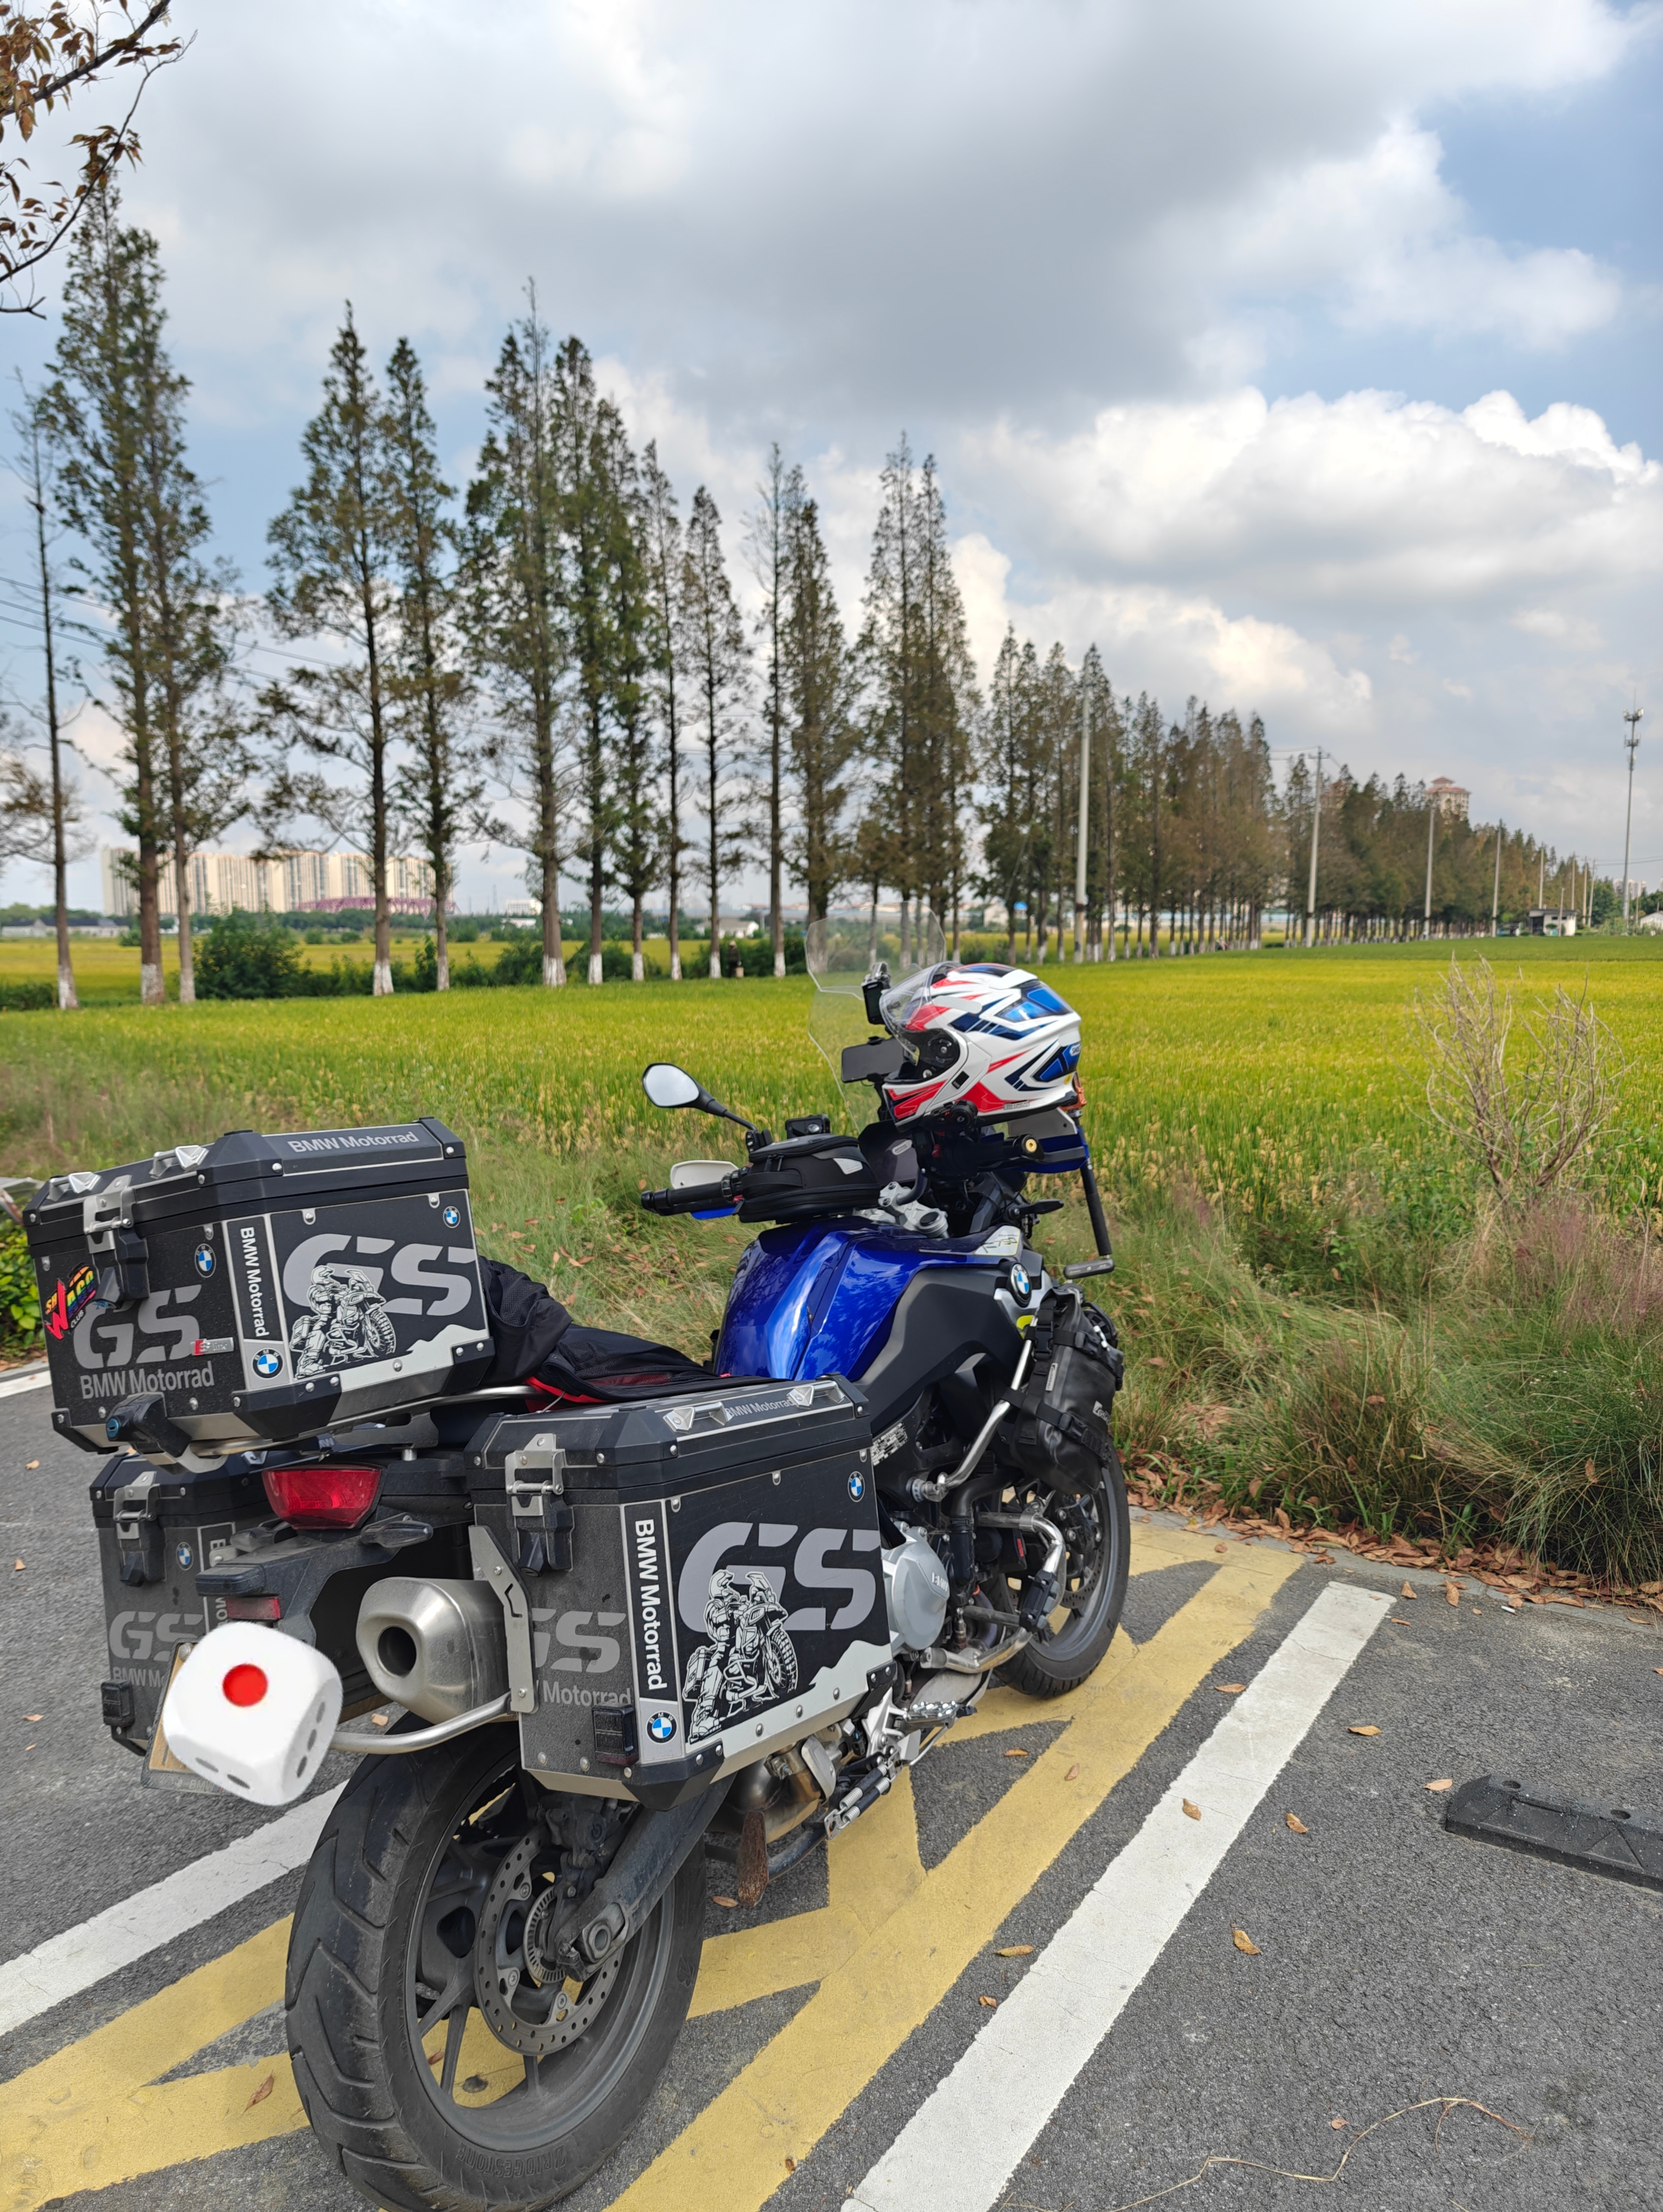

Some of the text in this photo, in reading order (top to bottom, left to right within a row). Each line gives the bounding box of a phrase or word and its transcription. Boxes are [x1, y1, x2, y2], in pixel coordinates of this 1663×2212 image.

[287, 1131, 420, 1152] BMW Motorrad
[240, 1227, 270, 1337] BMW Motorrad
[283, 1233, 476, 1316] GS
[70, 1310, 84, 1328] CLUB
[73, 1284, 202, 1369] GS
[80, 1360, 215, 1400] BMW Motorrad
[725, 1404, 753, 1417] BMW
[750, 1397, 796, 1413] Motorrad
[678, 1521, 881, 1633] GS
[635, 1519, 668, 1691] BMW Motorrad
[109, 1610, 203, 1662] GS
[542, 1679, 631, 1707] Motorrad
[456, 2142, 567, 2179] BRIDGESTONE
